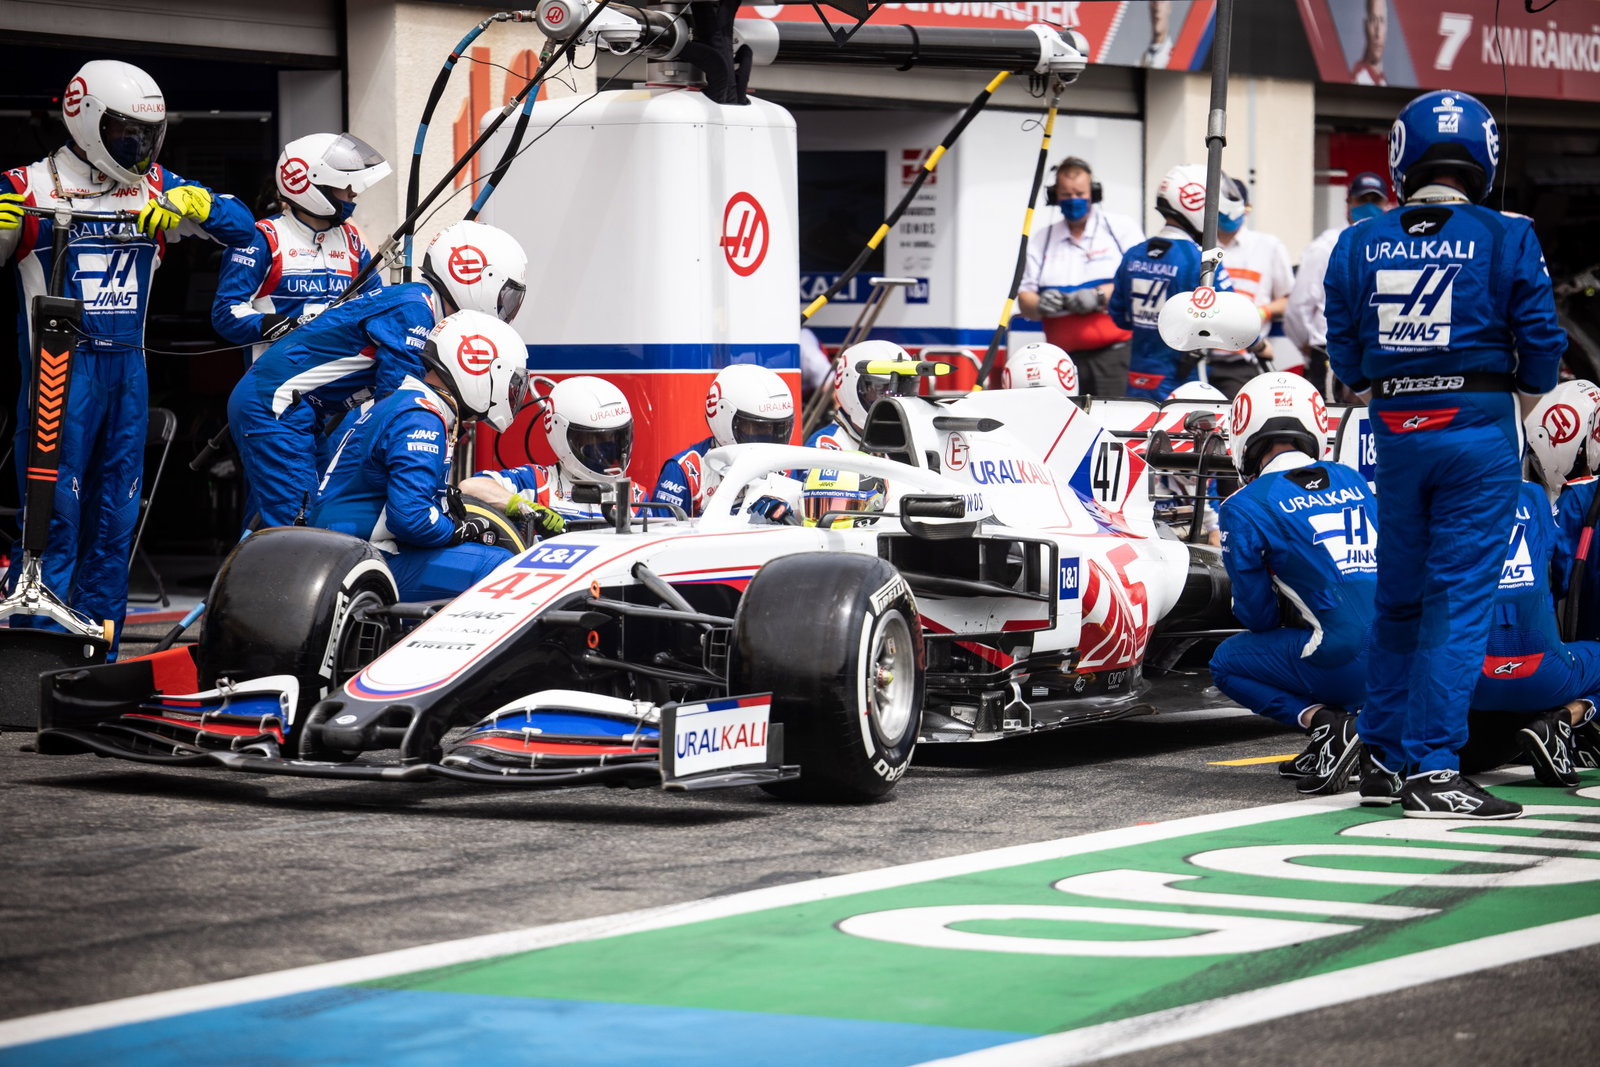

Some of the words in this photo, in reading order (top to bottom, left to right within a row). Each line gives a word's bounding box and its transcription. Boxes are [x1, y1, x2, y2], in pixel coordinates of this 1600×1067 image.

[1435, 12, 1473, 70] 7
[1482, 25, 1528, 66] KIMI
[111, 187, 140, 198] HAAS
[1366, 239, 1475, 262] URALKALI
[83, 292, 138, 307] HAAS
[408, 325, 431, 340] HAA
[1379, 322, 1451, 341] HAAS
[407, 429, 440, 441] HAAS
[1361, 433, 1377, 466] 1&
[970, 459, 1050, 486] URALKALI
[1093, 441, 1124, 502] 47
[660, 479, 687, 494] HAAS
[960, 492, 984, 512] ONOS
[1279, 486, 1366, 514] URALKALI
[530, 547, 587, 564] 1&1
[1335, 549, 1377, 565] HAA
[478, 571, 567, 600] 47
[1061, 566, 1078, 589] 1&1
[446, 610, 516, 620] HAAS
[406, 640, 476, 651] PIRELLI
[677, 721, 767, 759] URALKALI
